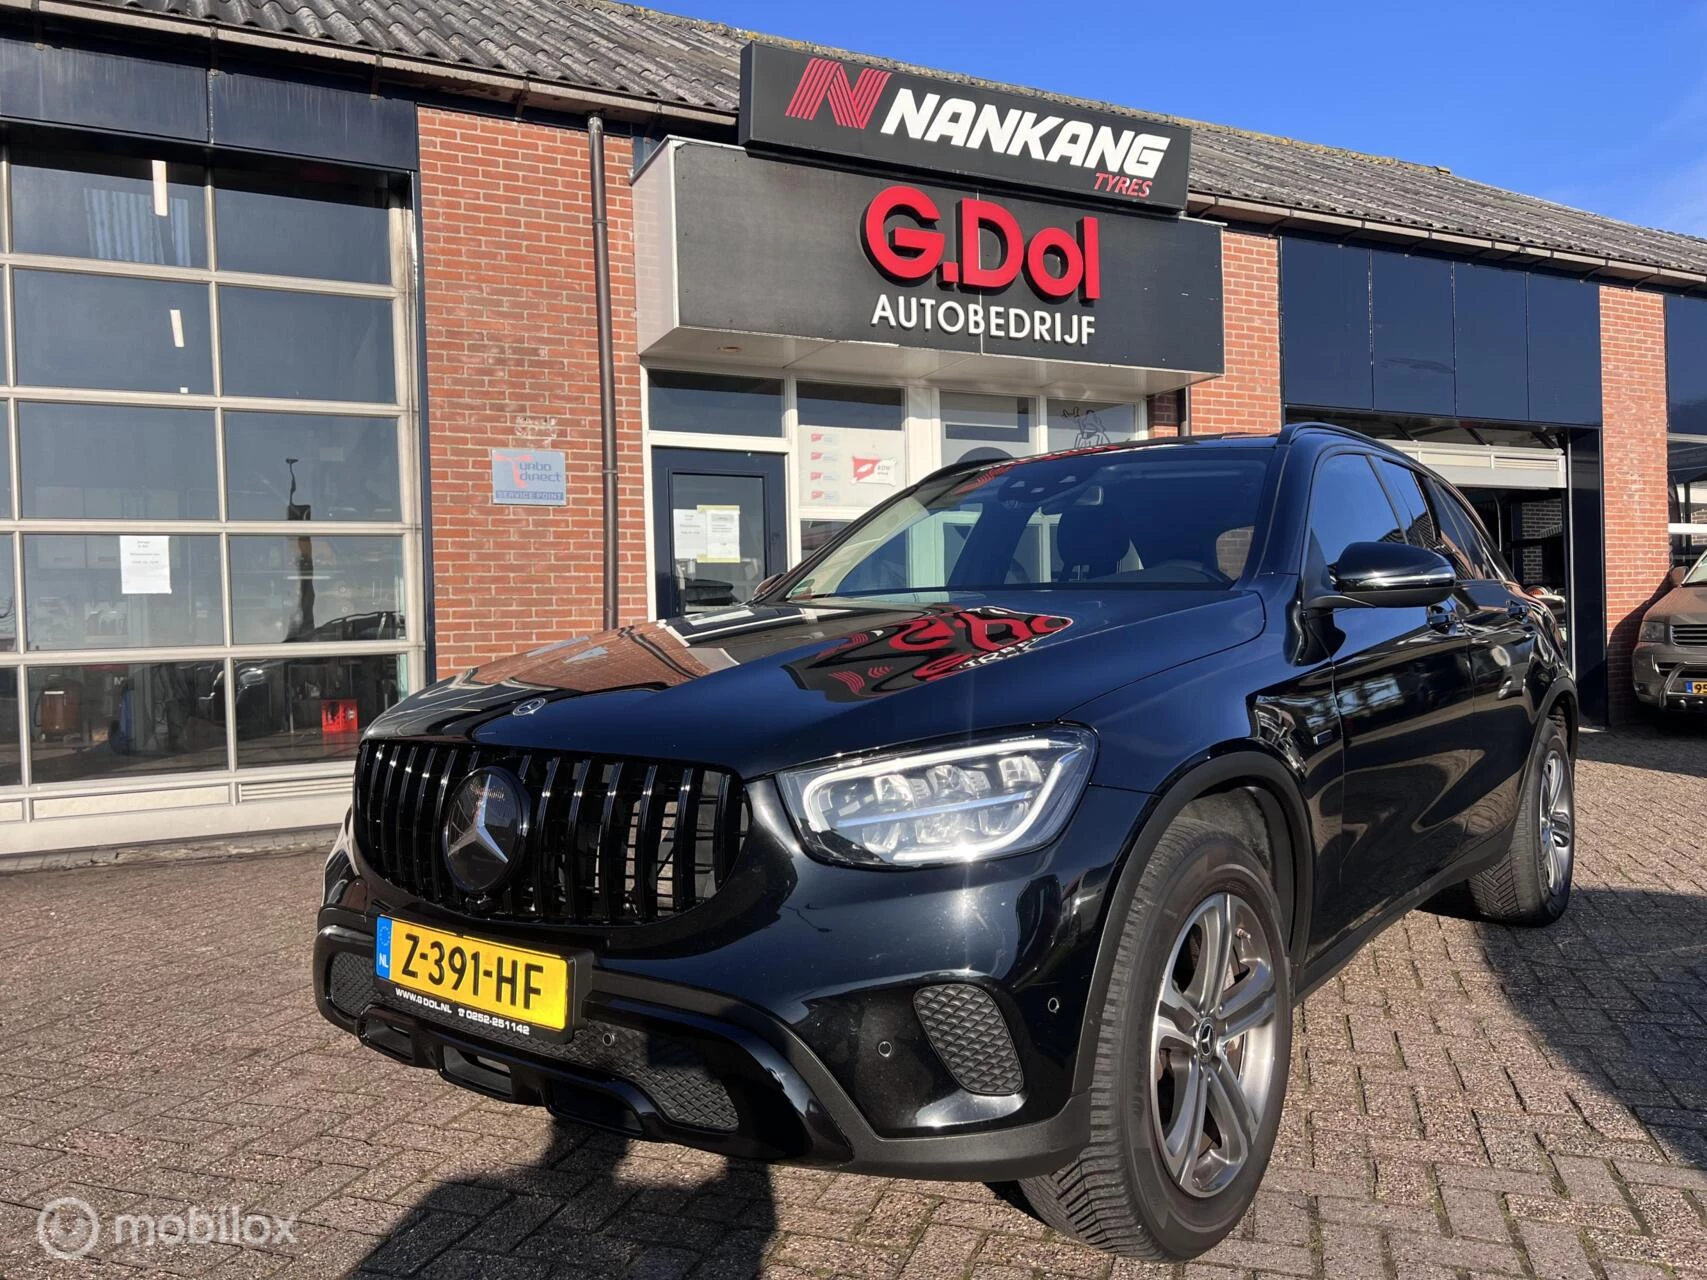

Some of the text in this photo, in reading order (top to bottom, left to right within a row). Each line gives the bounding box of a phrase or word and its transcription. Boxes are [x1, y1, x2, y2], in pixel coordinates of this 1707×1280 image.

[880, 89, 1171, 179] NANKANG
[1093, 172, 1152, 198] TYRES
[862, 185, 1100, 300] G.Dol
[871, 294, 1095, 345] AUTOBEDRIJF
[379, 952, 389, 969] NL
[402, 932, 544, 1010] Z-391-HF
